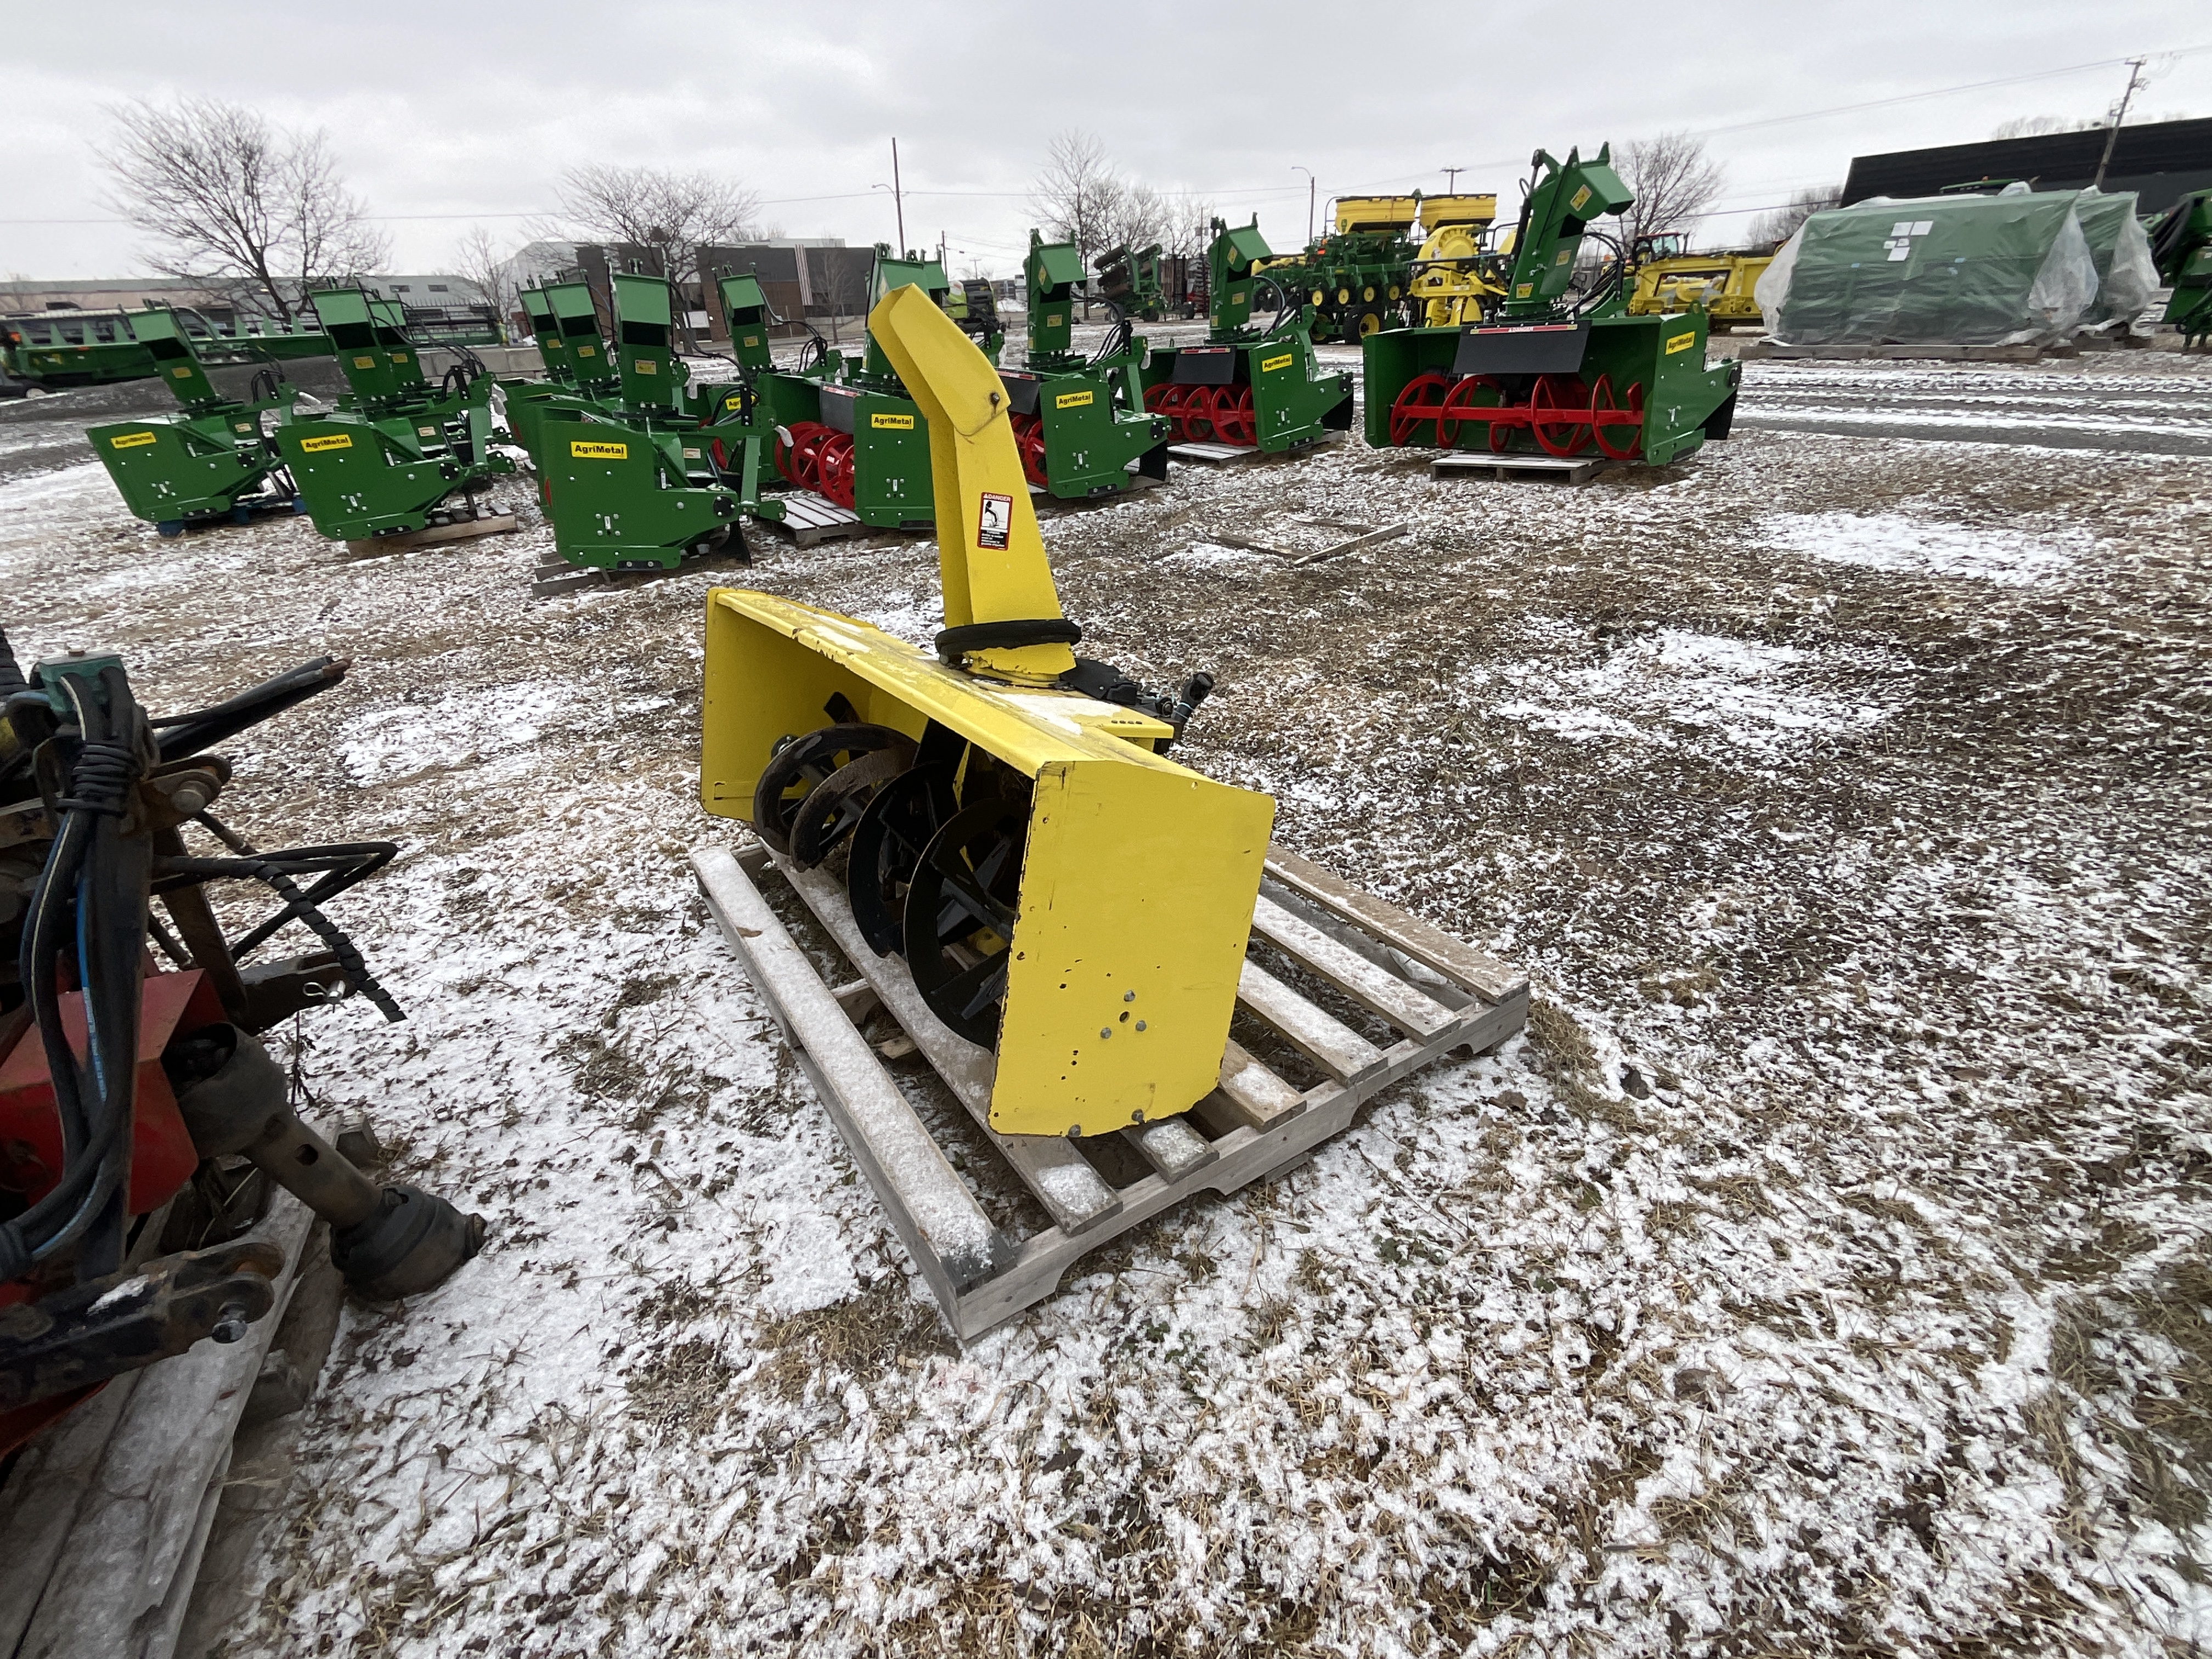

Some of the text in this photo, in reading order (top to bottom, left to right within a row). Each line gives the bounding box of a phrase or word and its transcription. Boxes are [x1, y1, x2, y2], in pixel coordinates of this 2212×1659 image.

[1059, 393, 1091, 405] AgriMetal
[874, 417, 912, 425] AgriMetal
[306, 437, 349, 449] AgriMetal
[575, 444, 624, 454] AgriMetal
